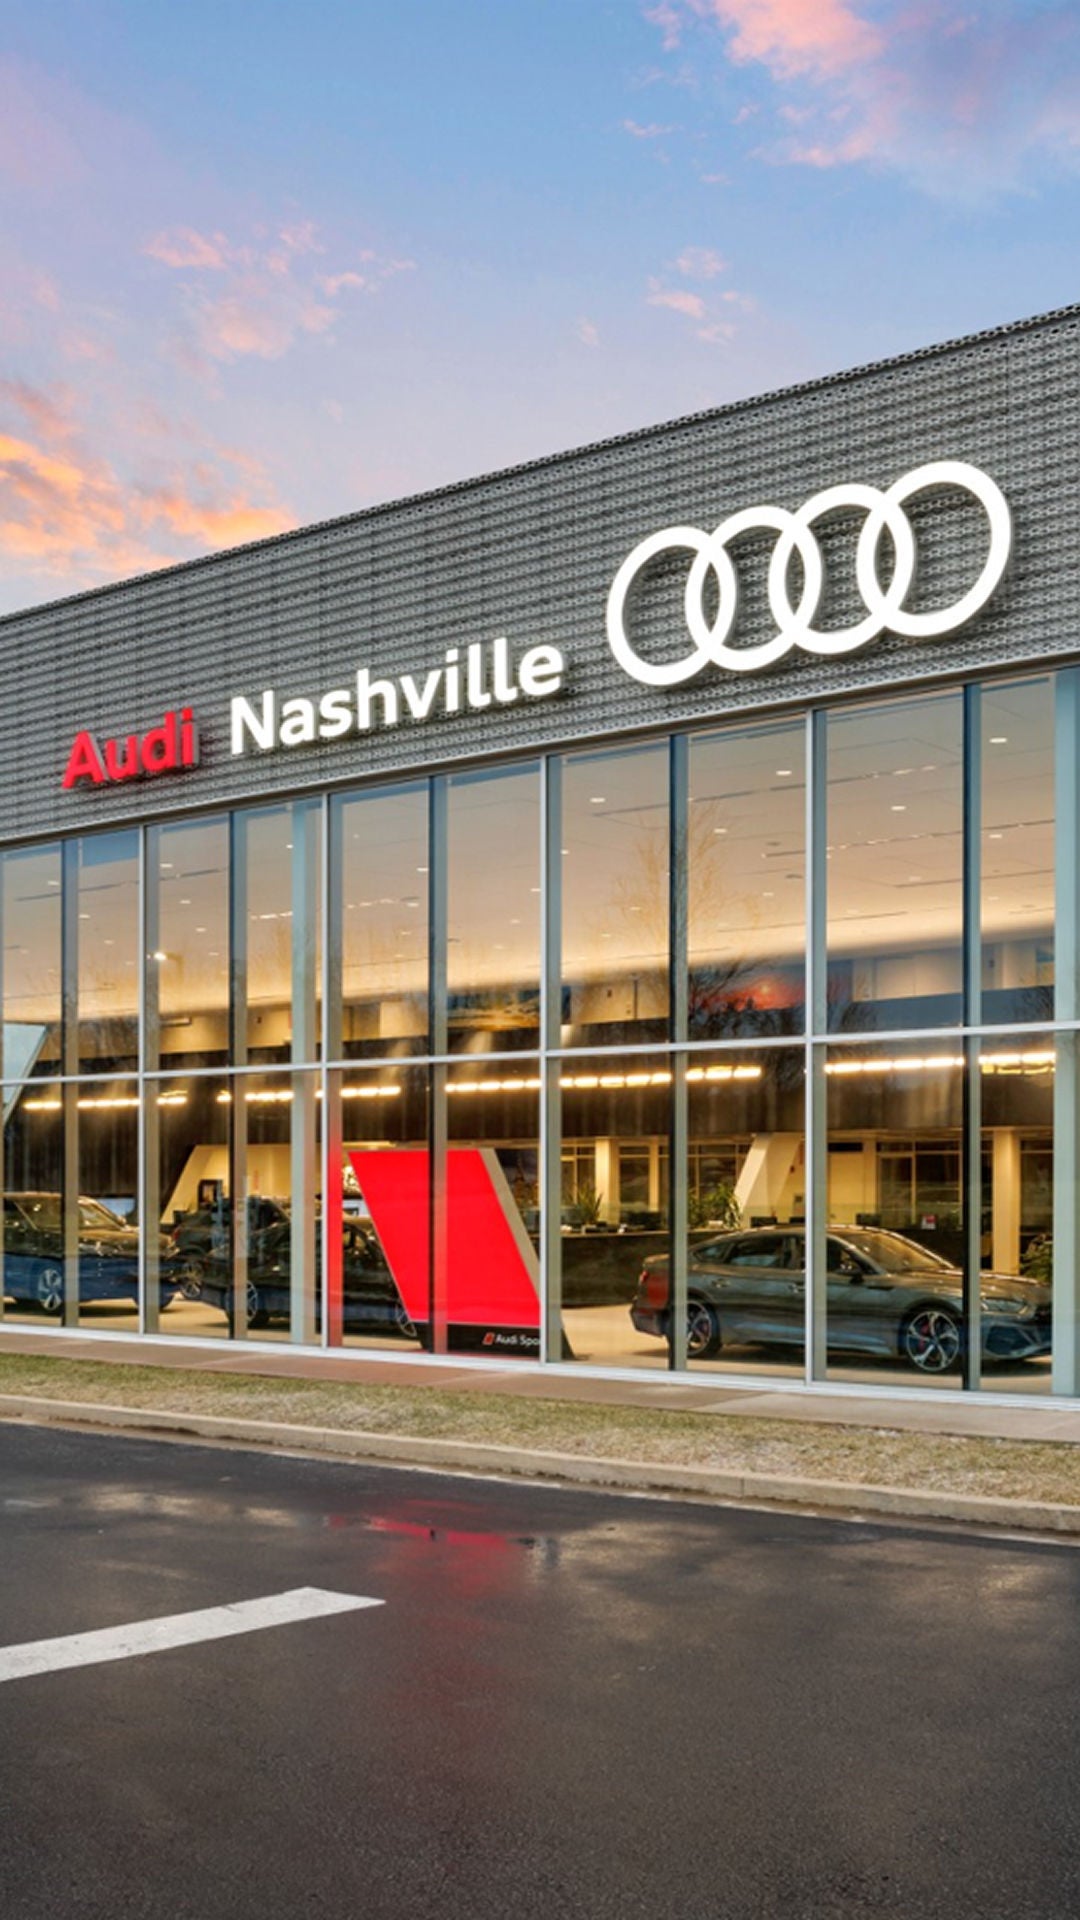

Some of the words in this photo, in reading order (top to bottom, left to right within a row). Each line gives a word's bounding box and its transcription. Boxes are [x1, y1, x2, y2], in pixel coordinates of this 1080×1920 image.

[62, 707, 194, 789] Audi
[230, 637, 563, 755] Nashville
[495, 1333, 517, 1344] Audi
[520, 1334, 540, 1347] Spo
